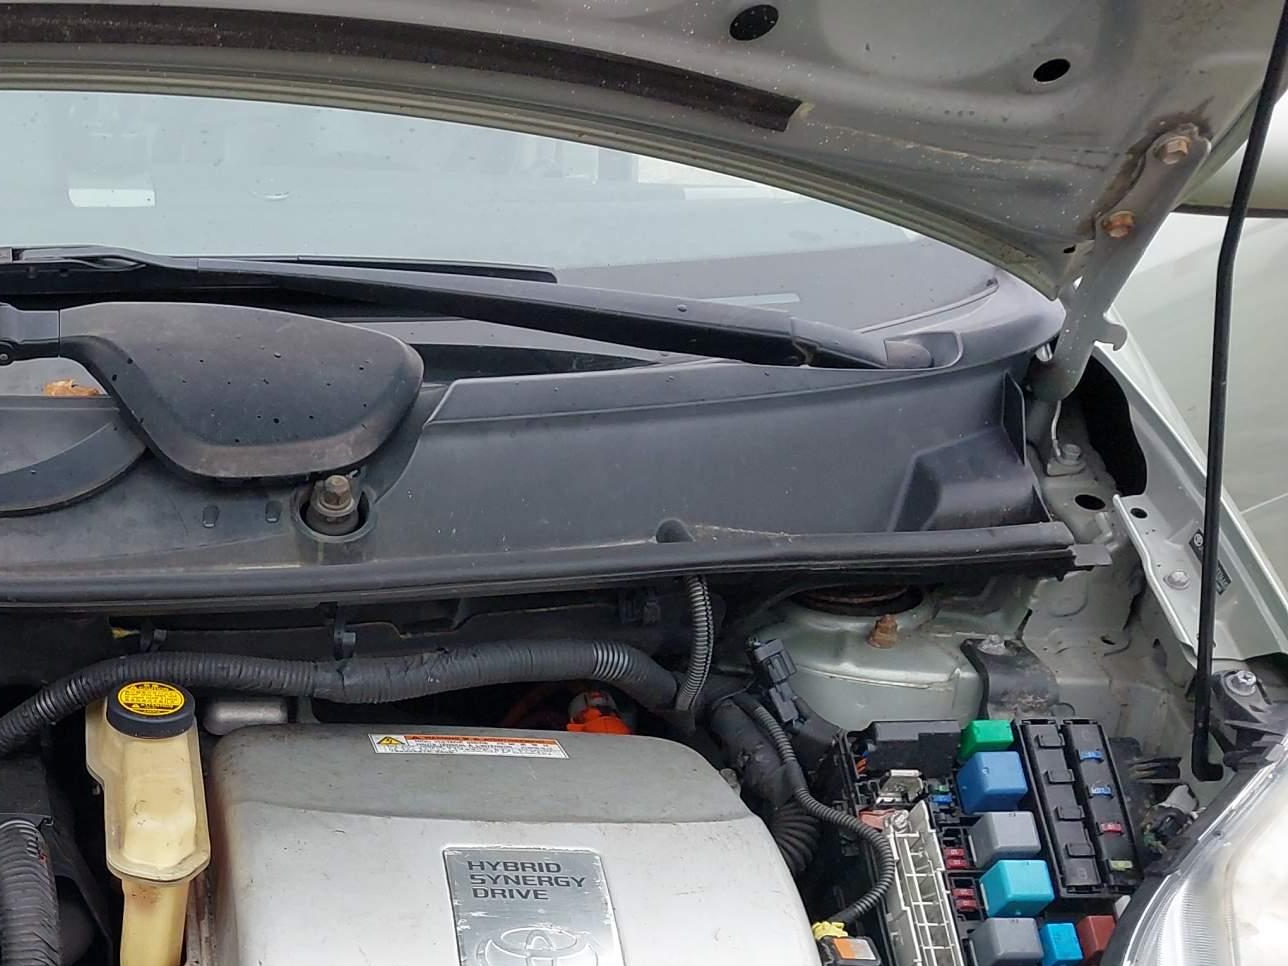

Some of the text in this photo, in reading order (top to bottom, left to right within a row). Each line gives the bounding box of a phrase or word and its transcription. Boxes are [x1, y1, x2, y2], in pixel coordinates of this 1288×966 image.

[467, 860, 562, 874] HYBRID
[470, 874, 587, 888] SYNERGY
[472, 887, 549, 900] DRIVE
